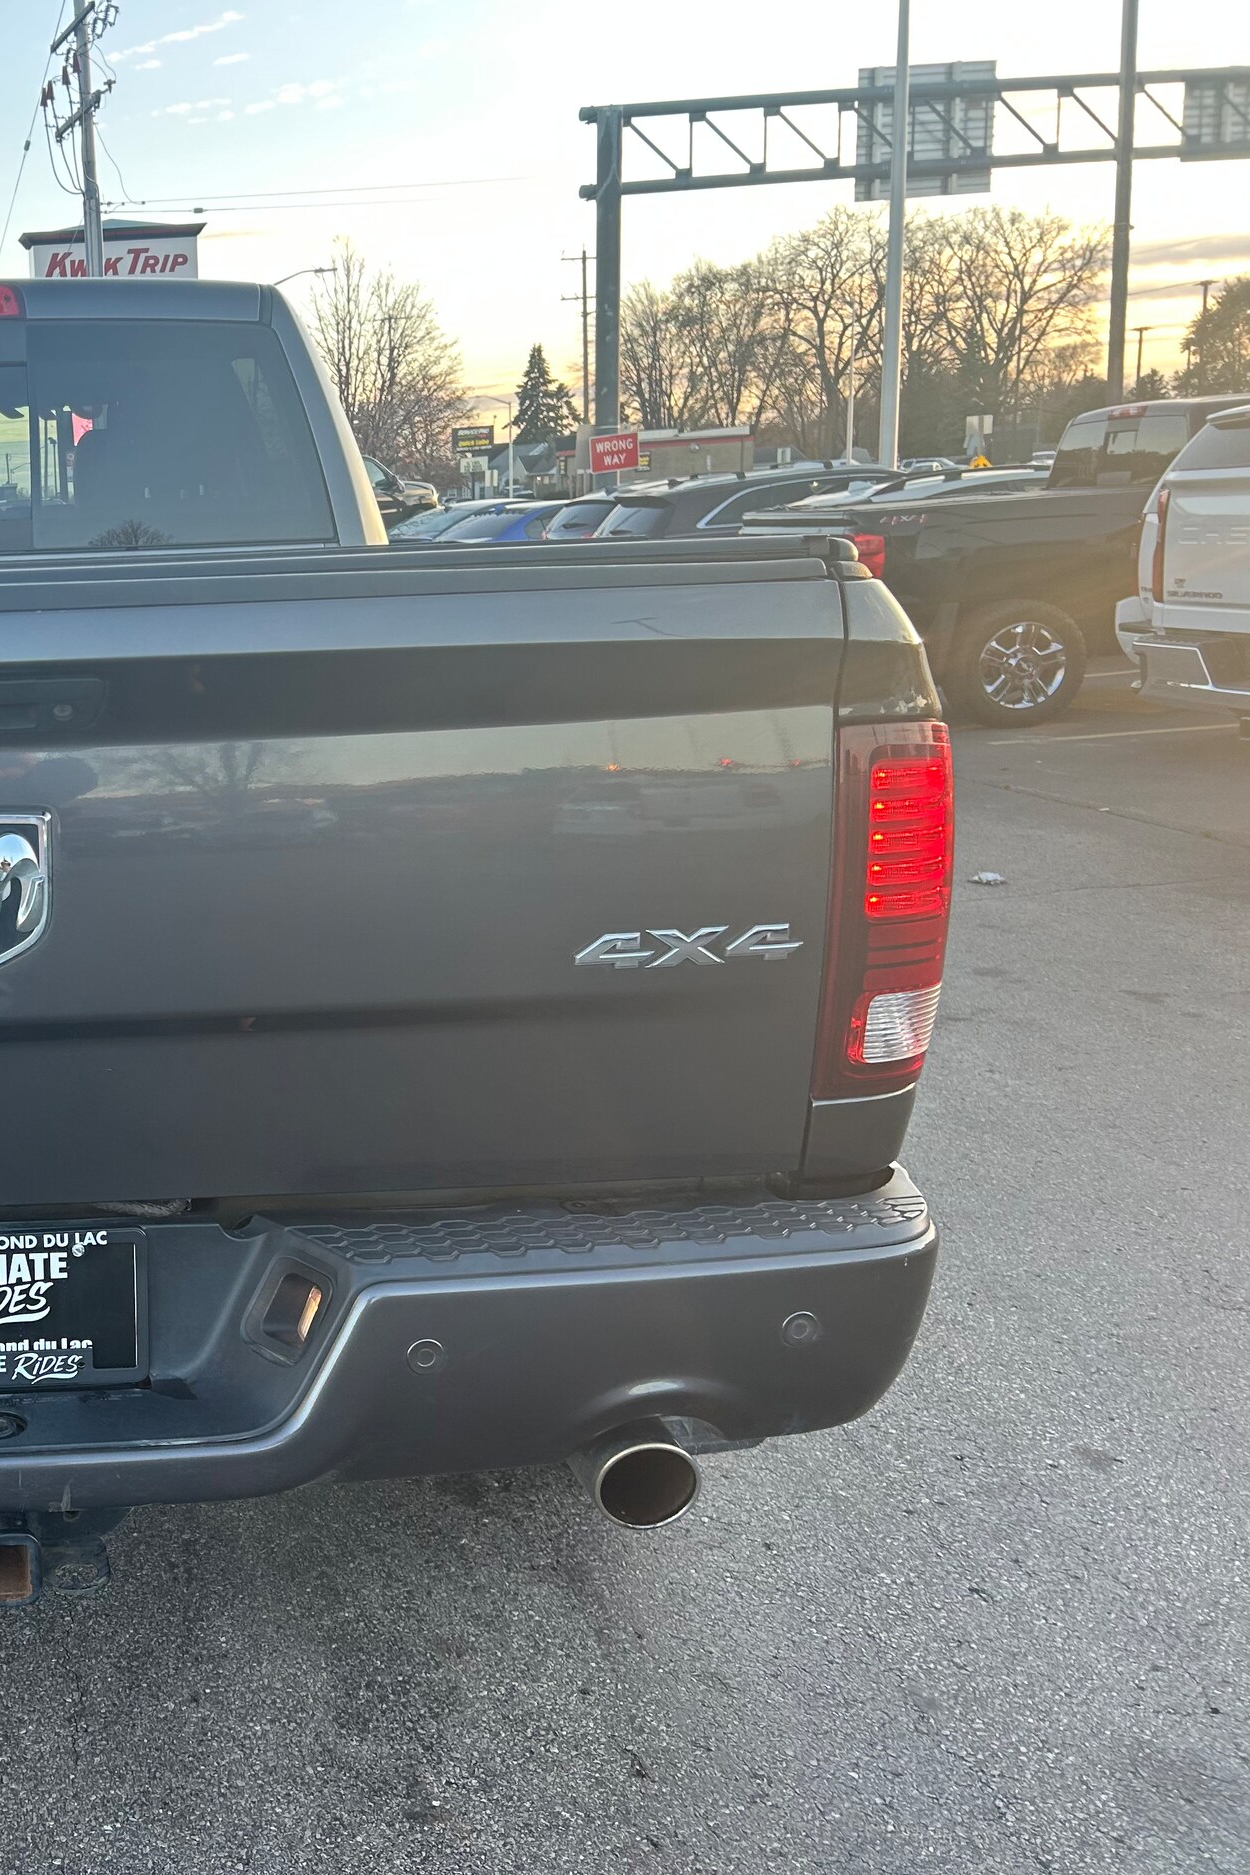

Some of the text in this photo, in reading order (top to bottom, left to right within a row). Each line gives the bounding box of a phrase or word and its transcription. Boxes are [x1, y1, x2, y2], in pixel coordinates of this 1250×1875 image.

[45, 247, 189, 278] KWK TRIP
[595, 438, 634, 453] WRONG
[603, 453, 627, 466] WAY
[43, 1233, 69, 1248] DU
[74, 1231, 108, 1247] LAC
